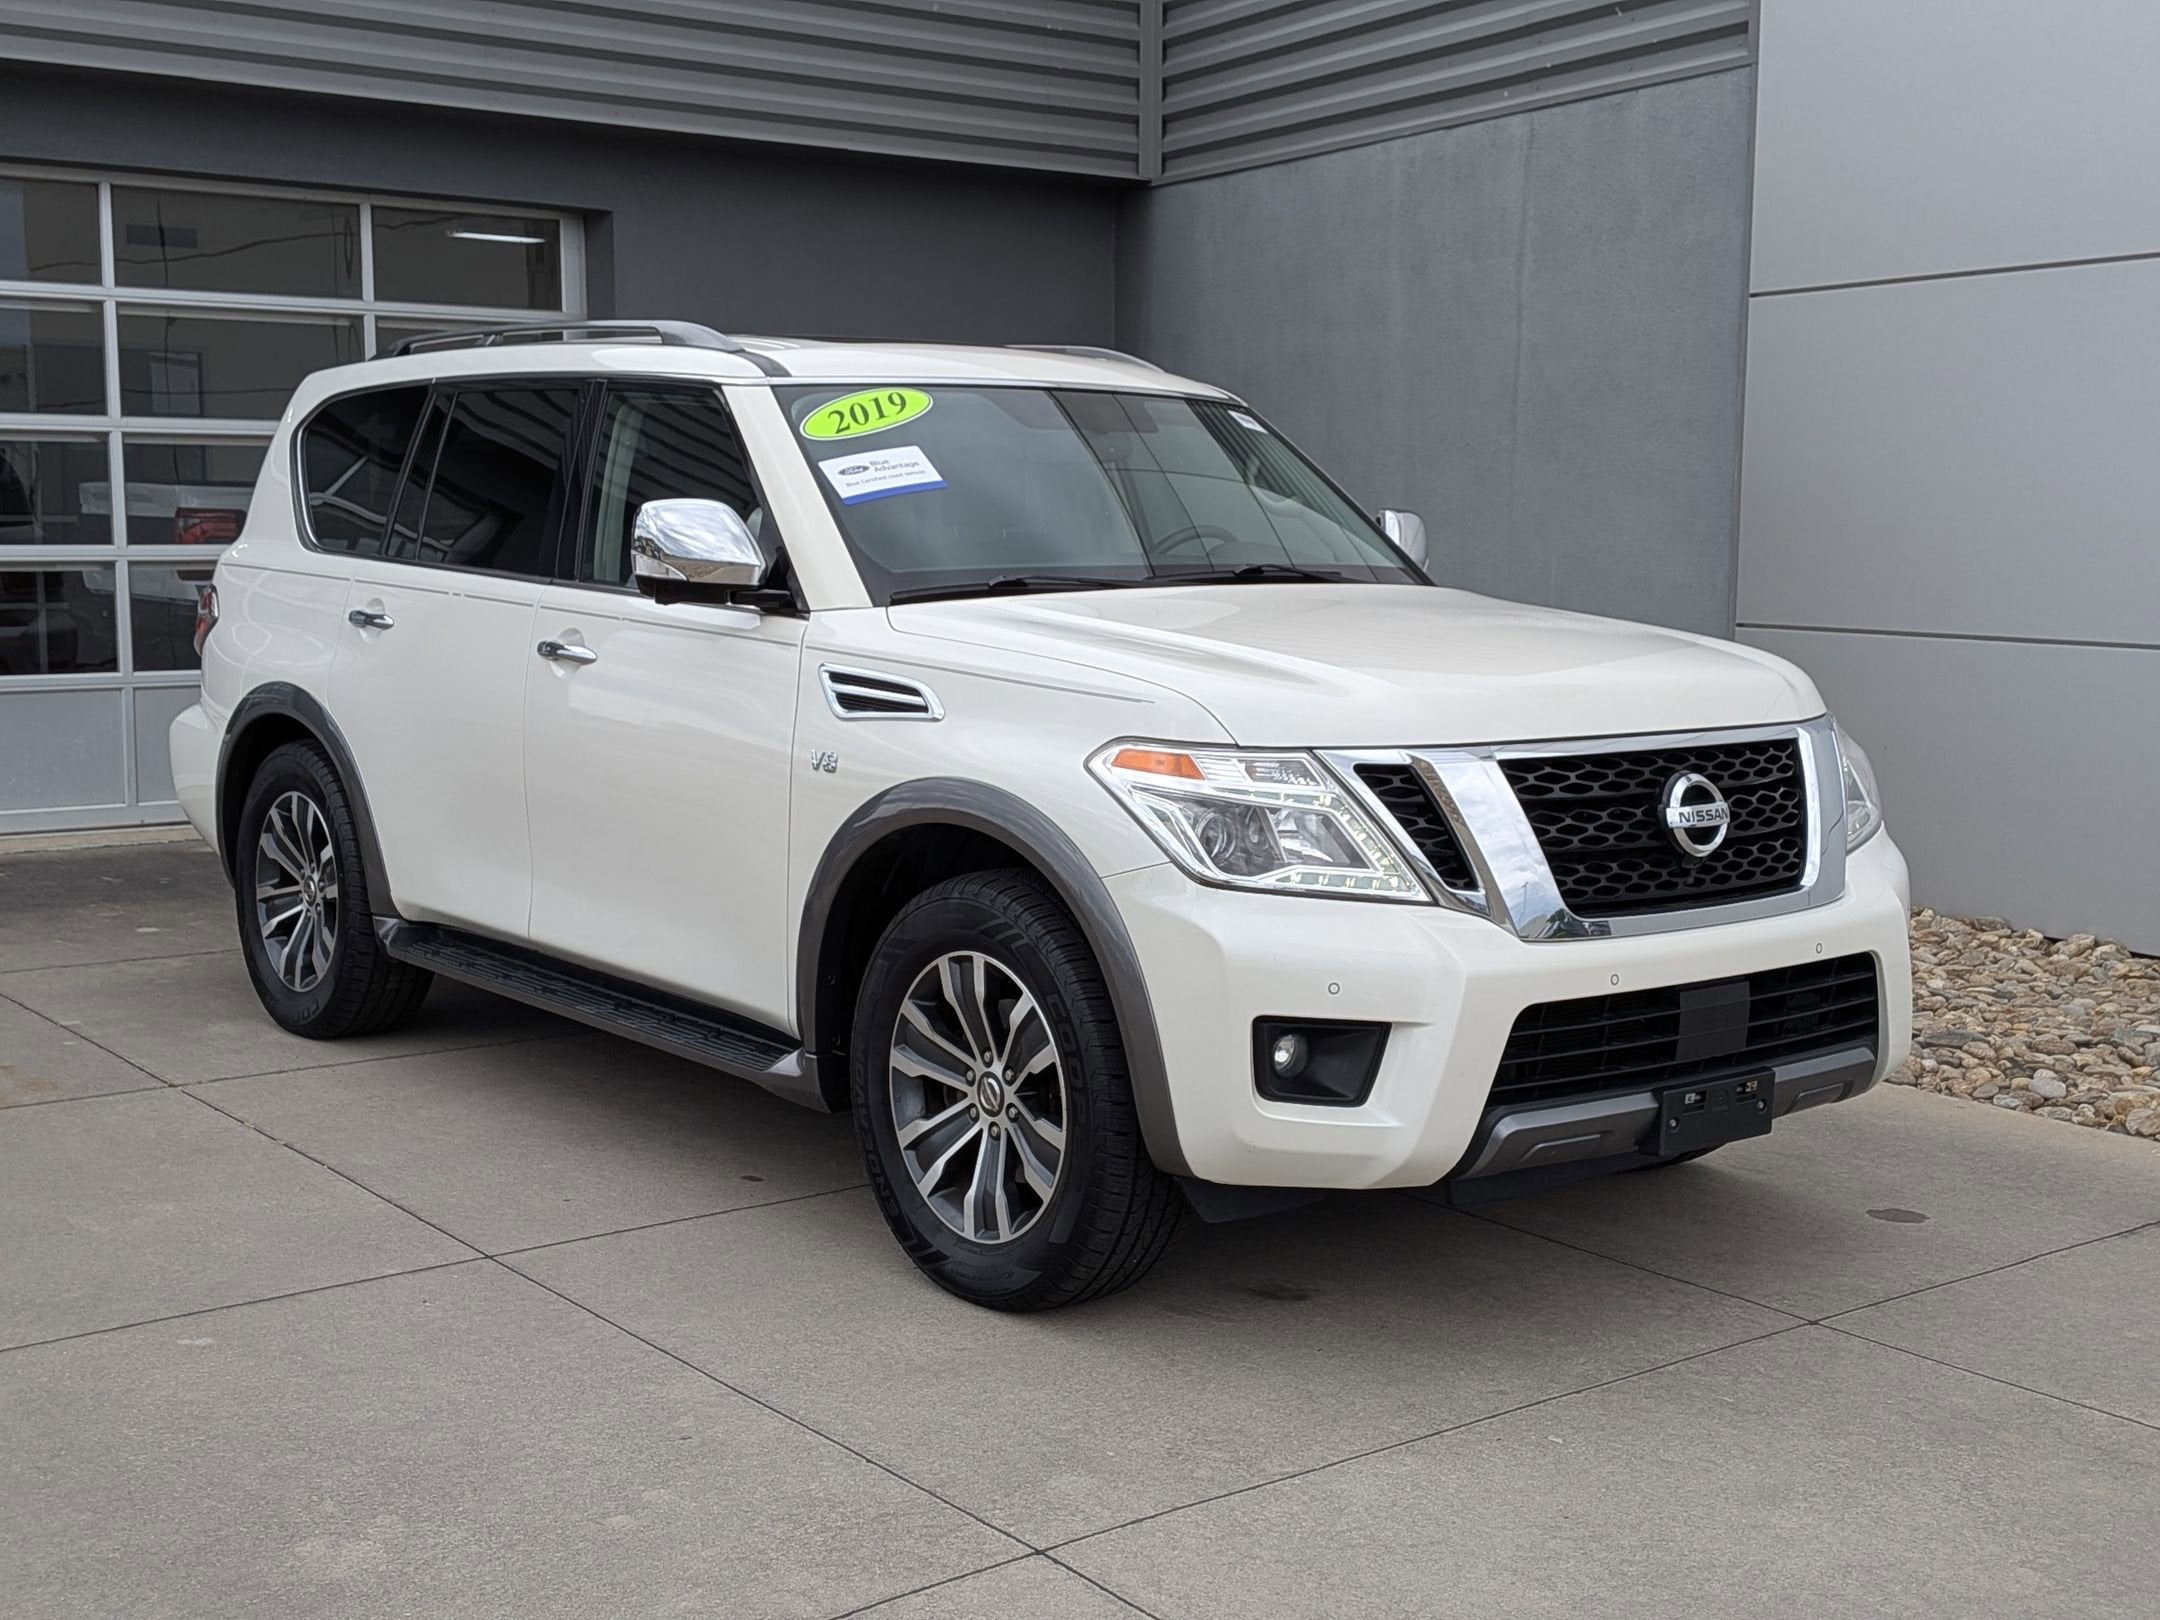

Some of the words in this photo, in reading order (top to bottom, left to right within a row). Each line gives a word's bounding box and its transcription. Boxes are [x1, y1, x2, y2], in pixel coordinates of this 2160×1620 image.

[828, 391, 907, 434] 2019
[874, 461, 920, 473] Advantage
[811, 750, 838, 773] V8
[1678, 807, 1729, 823] NISSAN
[1046, 993, 1086, 1178] COOPE
